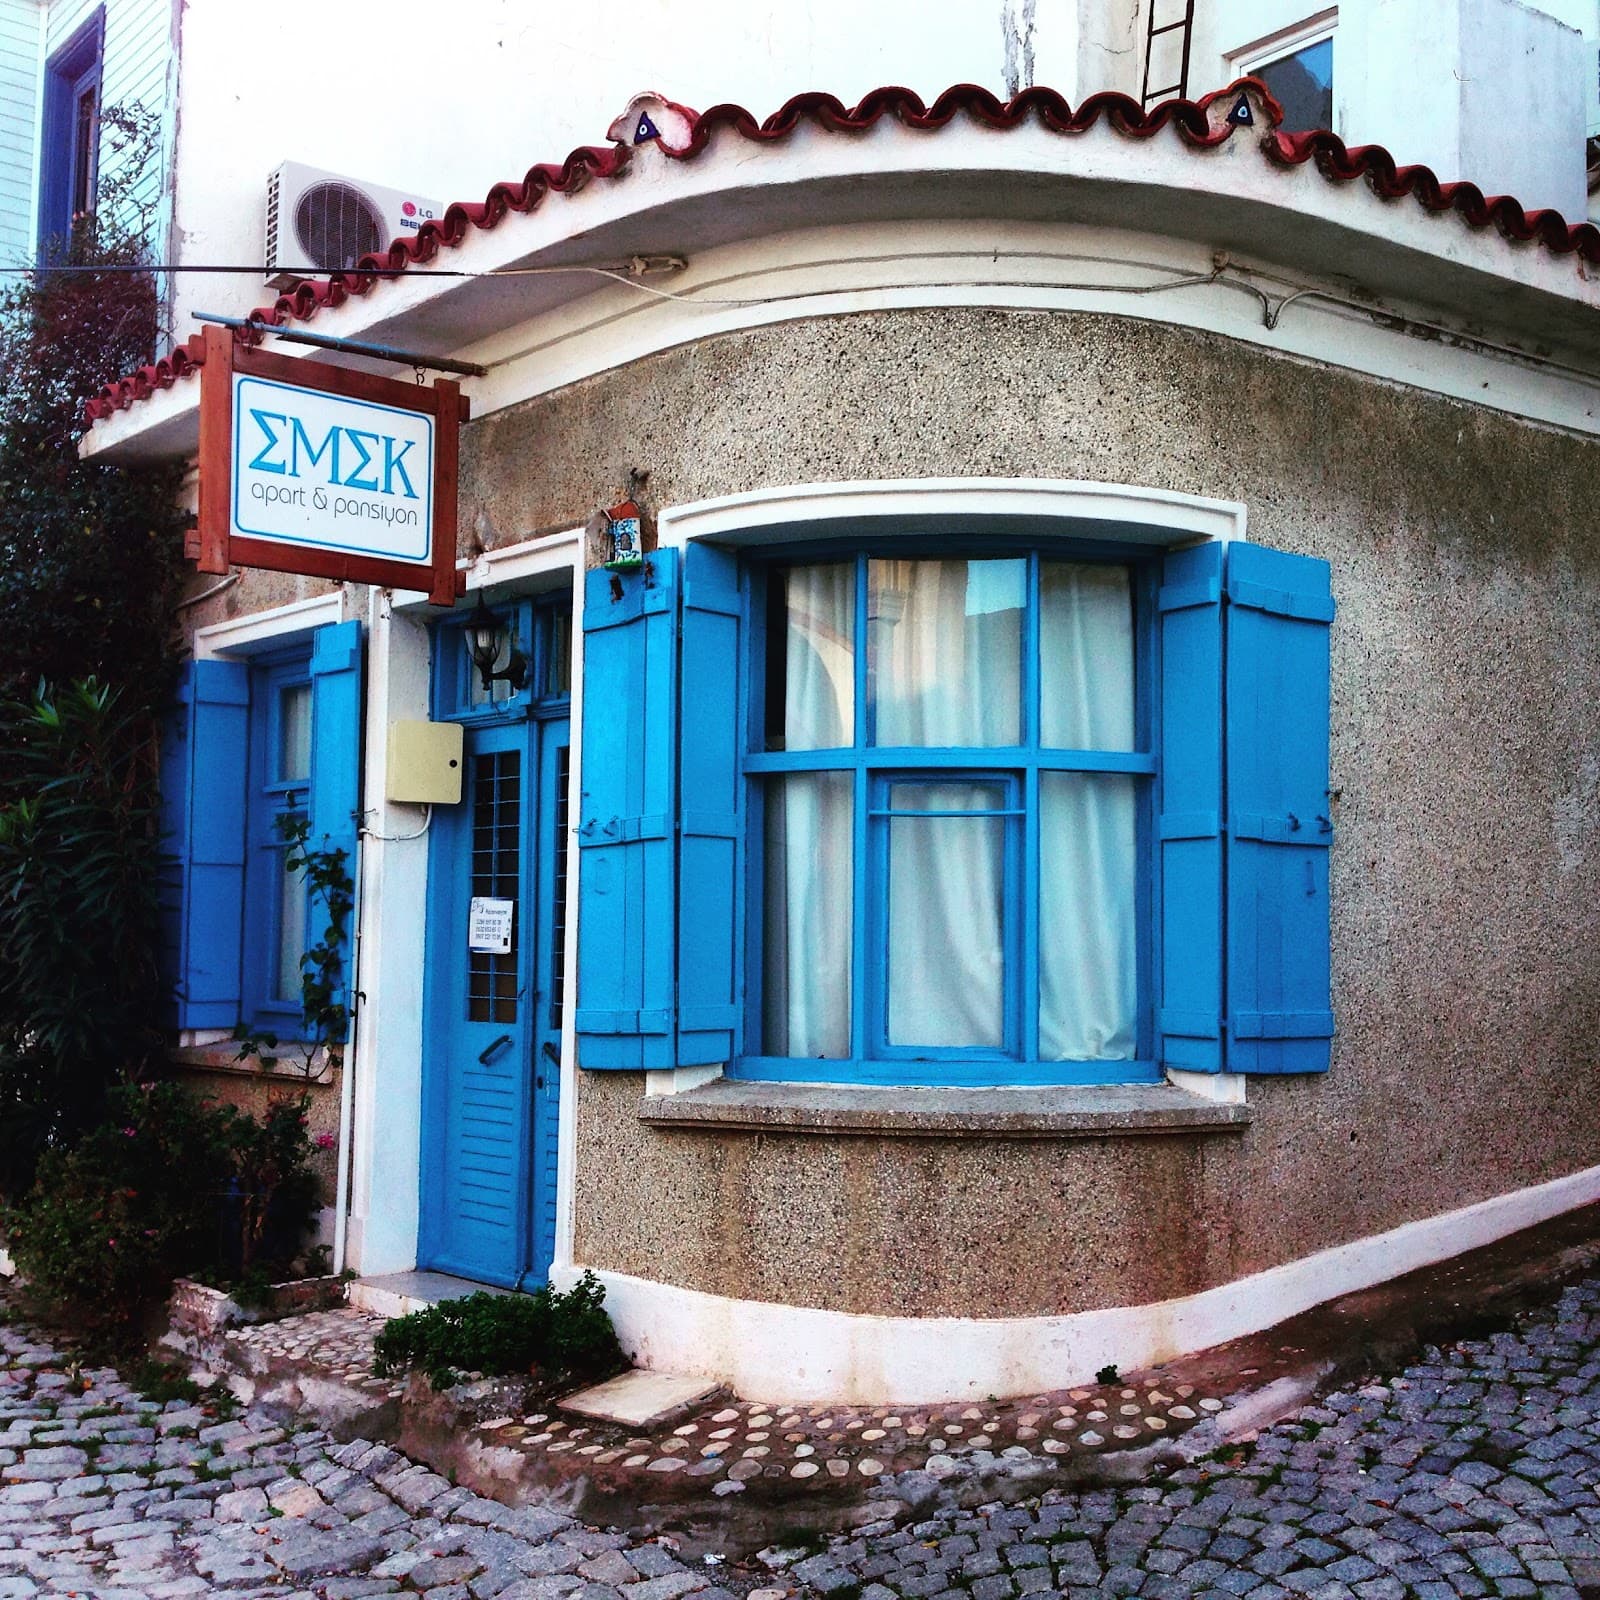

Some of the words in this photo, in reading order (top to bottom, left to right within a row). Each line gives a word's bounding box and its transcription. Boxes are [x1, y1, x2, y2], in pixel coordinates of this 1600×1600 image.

[419, 208, 433, 219] LG
[251, 481, 306, 507] apart
[312, 487, 328, 510] &
[334, 496, 417, 528] pansiyon
